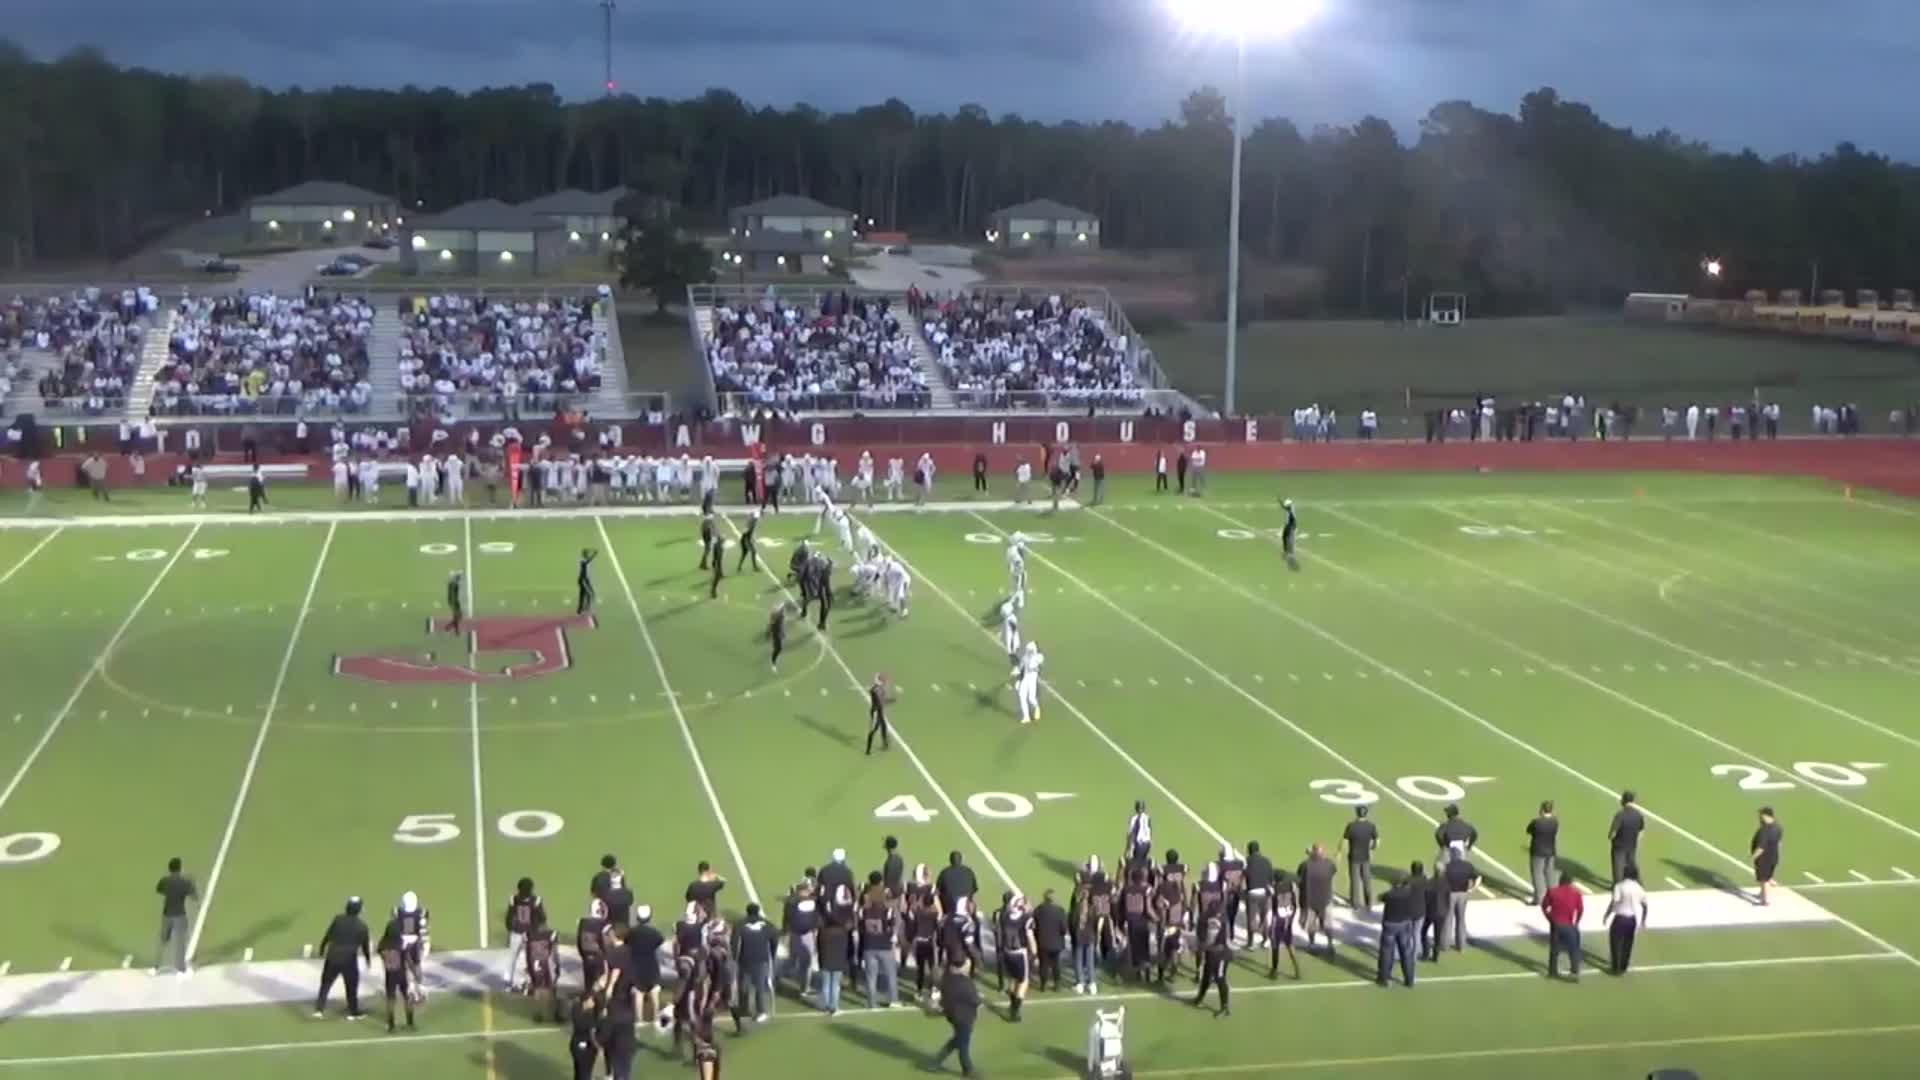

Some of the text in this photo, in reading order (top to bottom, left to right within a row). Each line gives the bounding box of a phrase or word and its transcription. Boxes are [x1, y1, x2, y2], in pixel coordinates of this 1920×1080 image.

[992, 420, 1258, 444] HOUSE
[1309, 775, 1465, 805] 30
[1711, 762, 1867, 789] 20
[874, 792, 1034, 822] 40
[393, 810, 564, 843] 50
